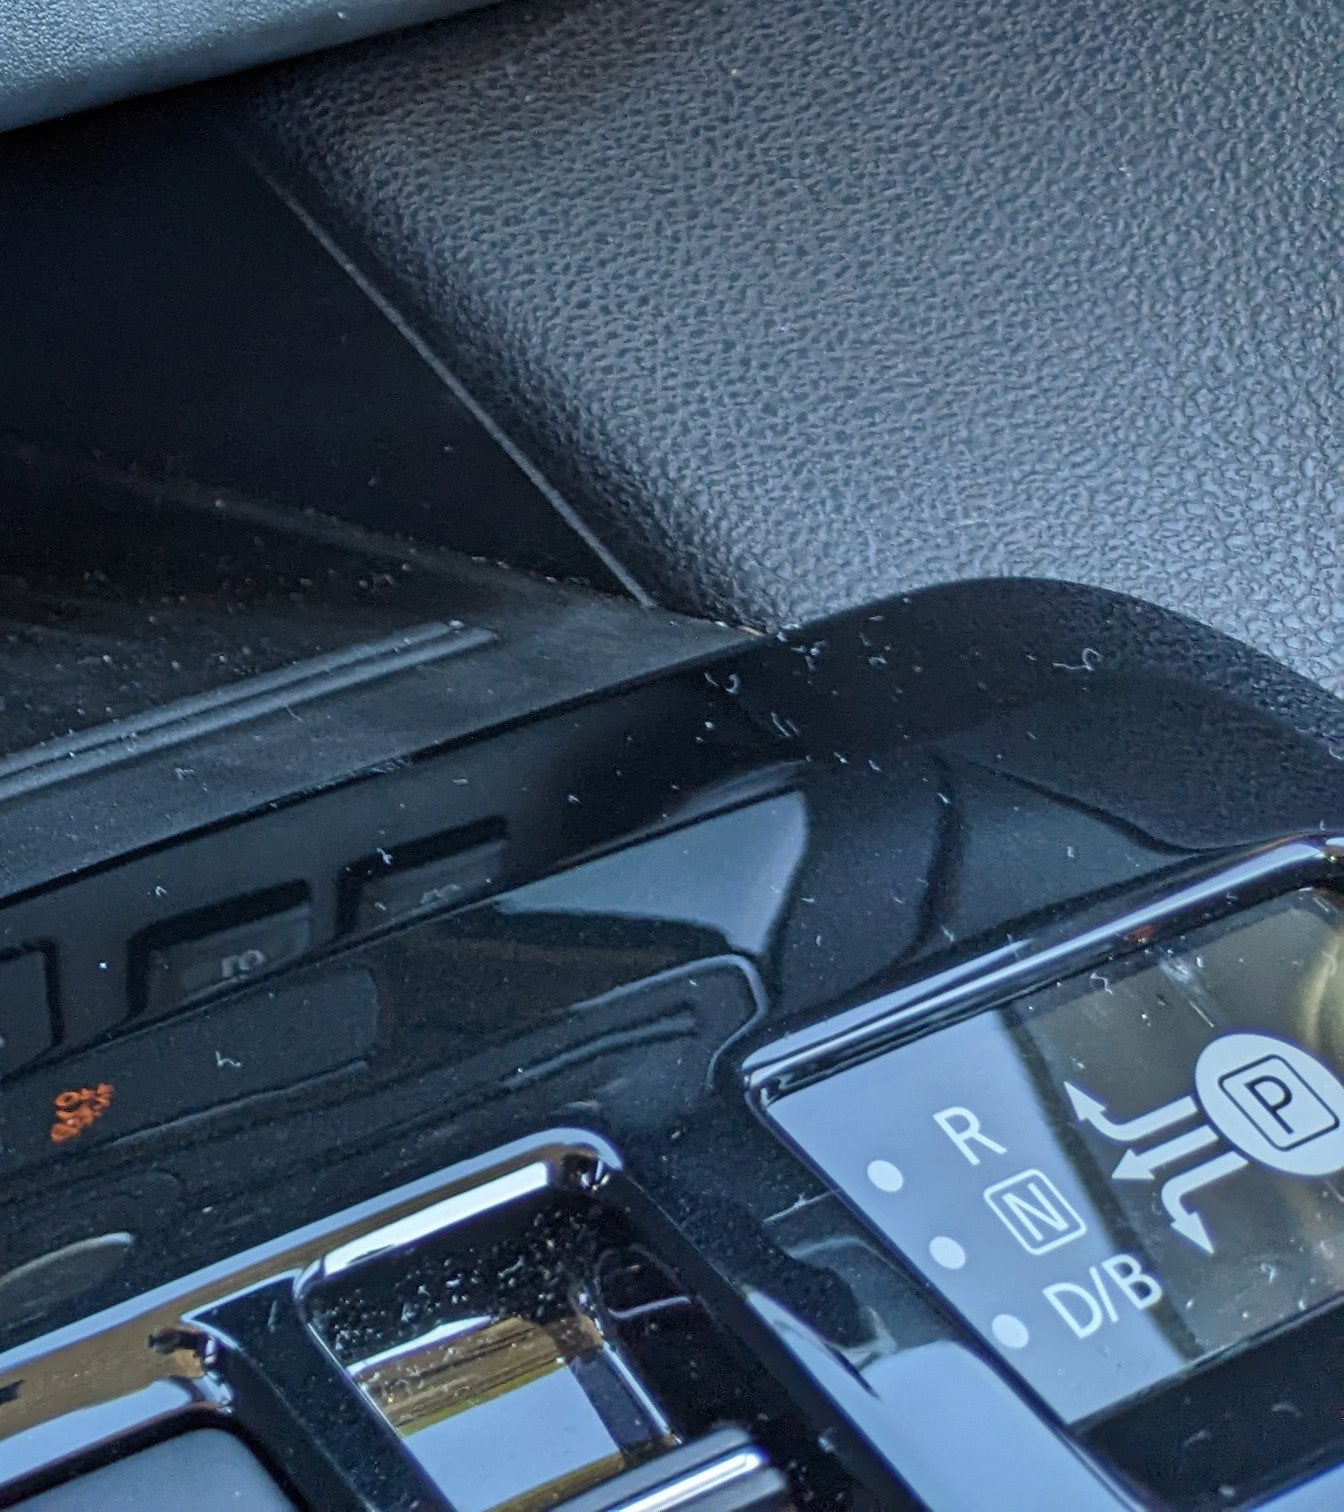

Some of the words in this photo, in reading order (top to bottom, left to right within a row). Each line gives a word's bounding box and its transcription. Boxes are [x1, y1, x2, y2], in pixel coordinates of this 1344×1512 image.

[1244, 1074, 1295, 1135] P
[933, 1106, 1007, 1166] R
[1002, 1183, 1068, 1242] N
[1042, 1253, 1163, 1340] D/B
